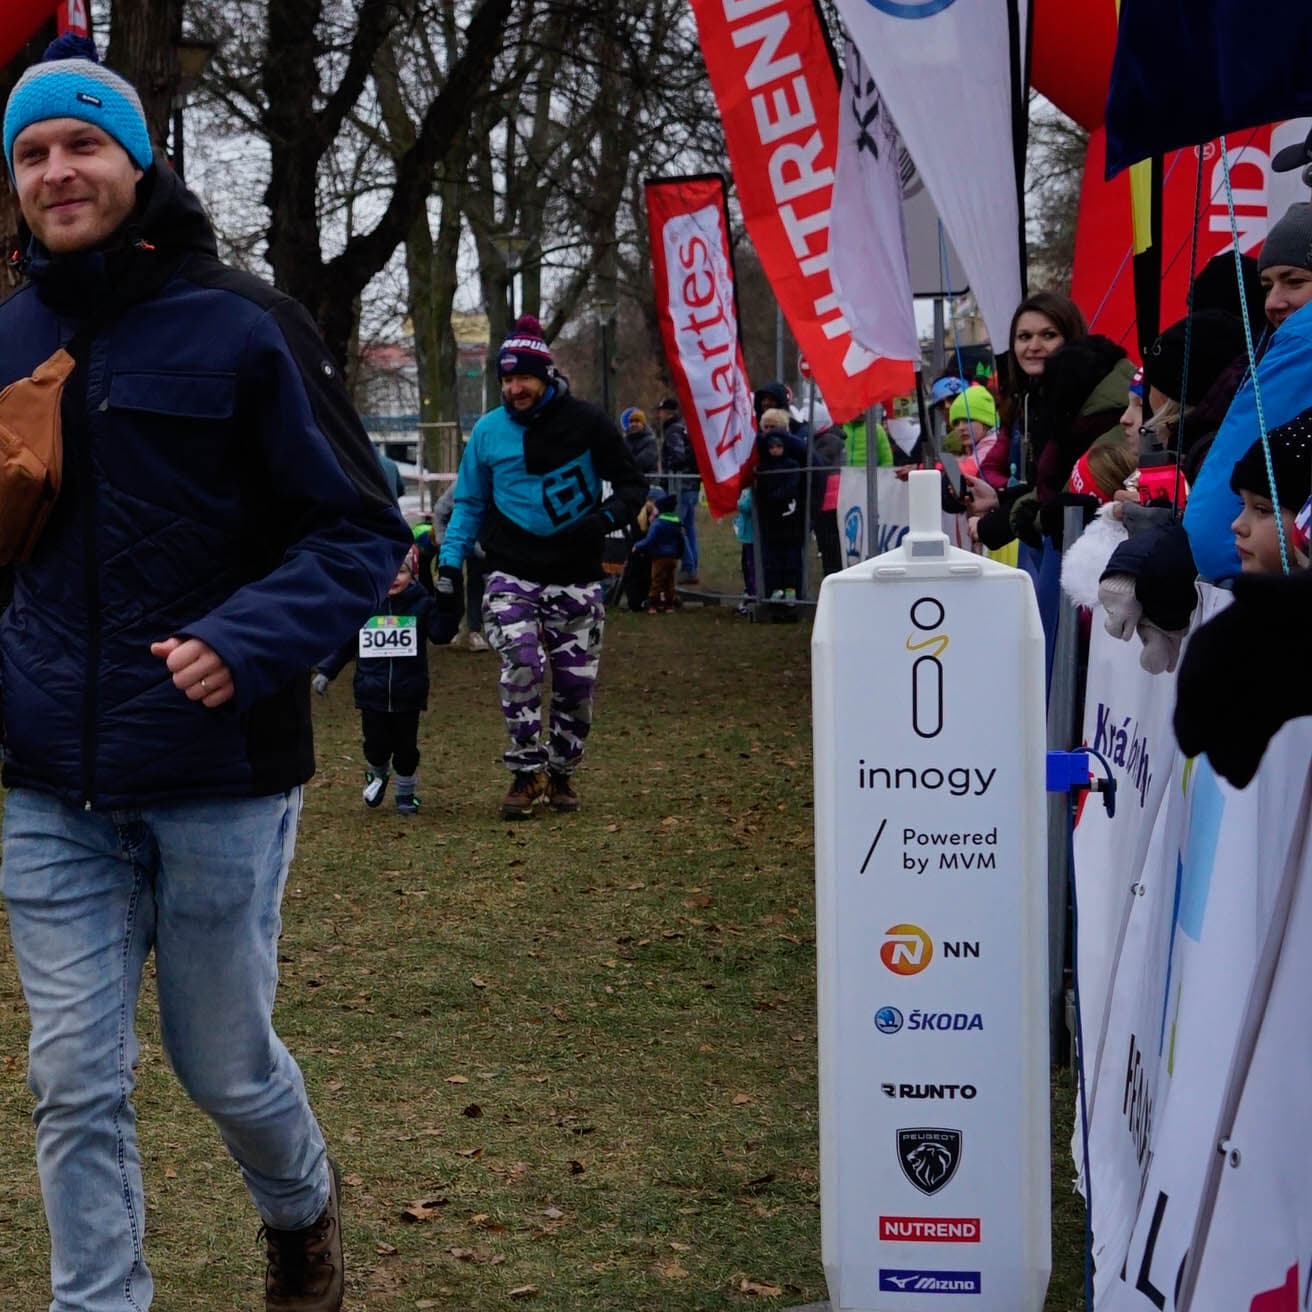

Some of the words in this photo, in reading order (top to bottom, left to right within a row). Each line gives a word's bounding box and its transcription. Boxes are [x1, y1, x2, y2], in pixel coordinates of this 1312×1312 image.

[679, 236, 742, 458] Nartes
[362, 630, 412, 648] 3046
[858, 758, 998, 796] innogy
[902, 827, 998, 845] Powered
[902, 851, 930, 875] by
[938, 852, 997, 870] MVM
[943, 941, 980, 958] NN
[907, 1009, 984, 1031] ŠKODA
[898, 1083, 977, 1099] RUNTO
[902, 1133, 956, 1142] PEUGEOT
[884, 1221, 977, 1238] NUTREND
